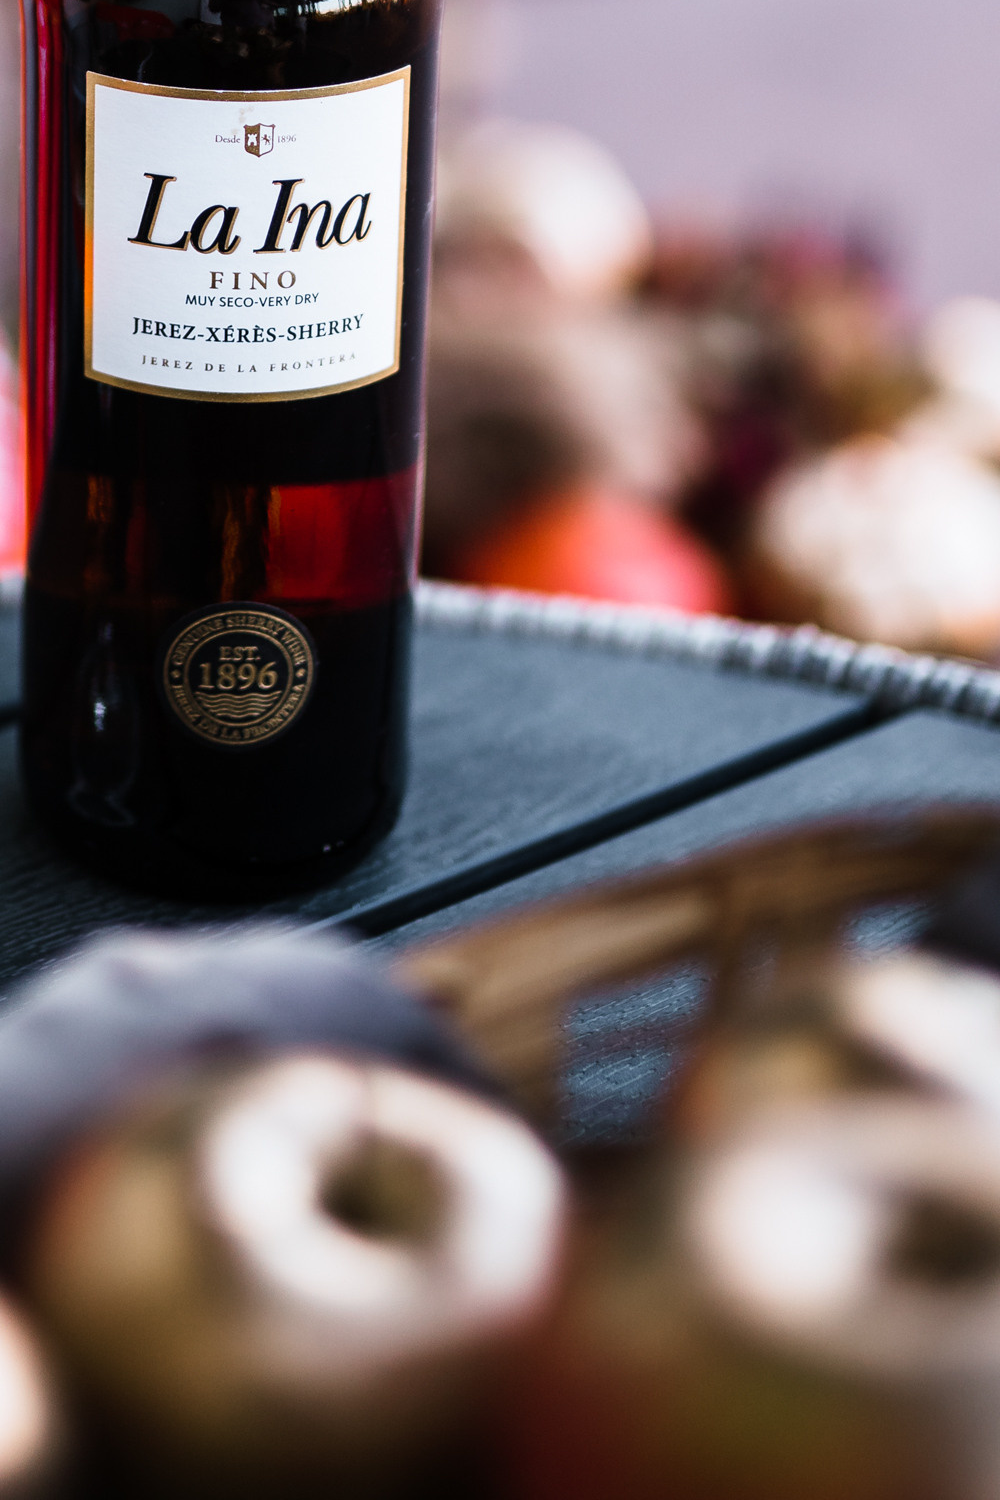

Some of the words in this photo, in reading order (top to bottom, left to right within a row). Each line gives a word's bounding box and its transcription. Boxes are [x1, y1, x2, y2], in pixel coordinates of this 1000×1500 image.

[215, 134, 241, 144] Desde
[277, 134, 297, 144] 1896
[127, 172, 241, 255] La
[253, 178, 372, 254] Ina
[209, 270, 298, 290] FINO
[185, 293, 216, 307] MUY
[219, 293, 293, 308] SECO-VERY
[294, 291, 320, 306] DRY
[132, 313, 365, 344] JEREZ-XÉRÈS-SHERRY
[141, 354, 194, 371] JEREZ
[204, 362, 227, 373] DE
[237, 363, 258, 373] LA
[269, 352, 357, 373] FRONTERA
[219, 645, 262, 661] EST.
[198, 661, 280, 690] 1896
